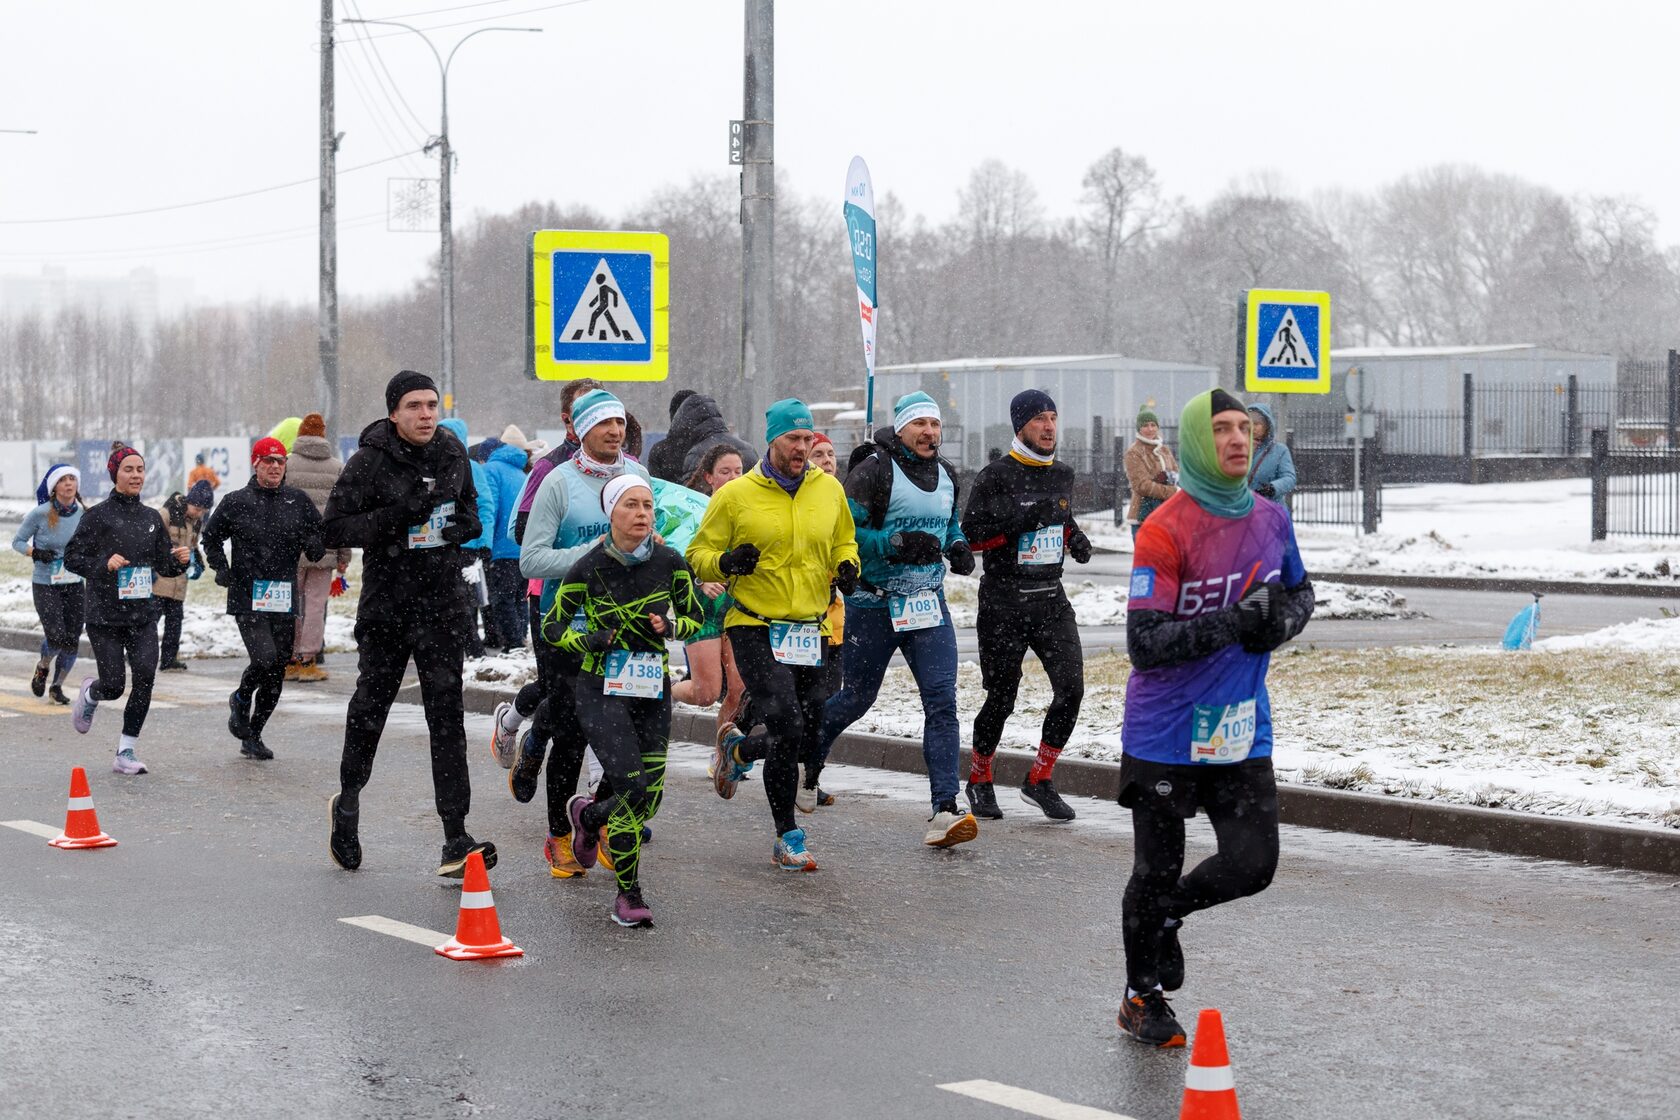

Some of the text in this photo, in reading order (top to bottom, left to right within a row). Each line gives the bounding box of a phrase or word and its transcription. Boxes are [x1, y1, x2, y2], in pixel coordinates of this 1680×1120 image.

[1037, 536, 1062, 548] 1110
[133, 576, 150, 585] 1314
[269, 590, 290, 599] 1313
[908, 599, 937, 613] 1081
[788, 636, 817, 648] 1161
[628, 664, 662, 679] 1388
[1222, 716, 1254, 739] 1078
